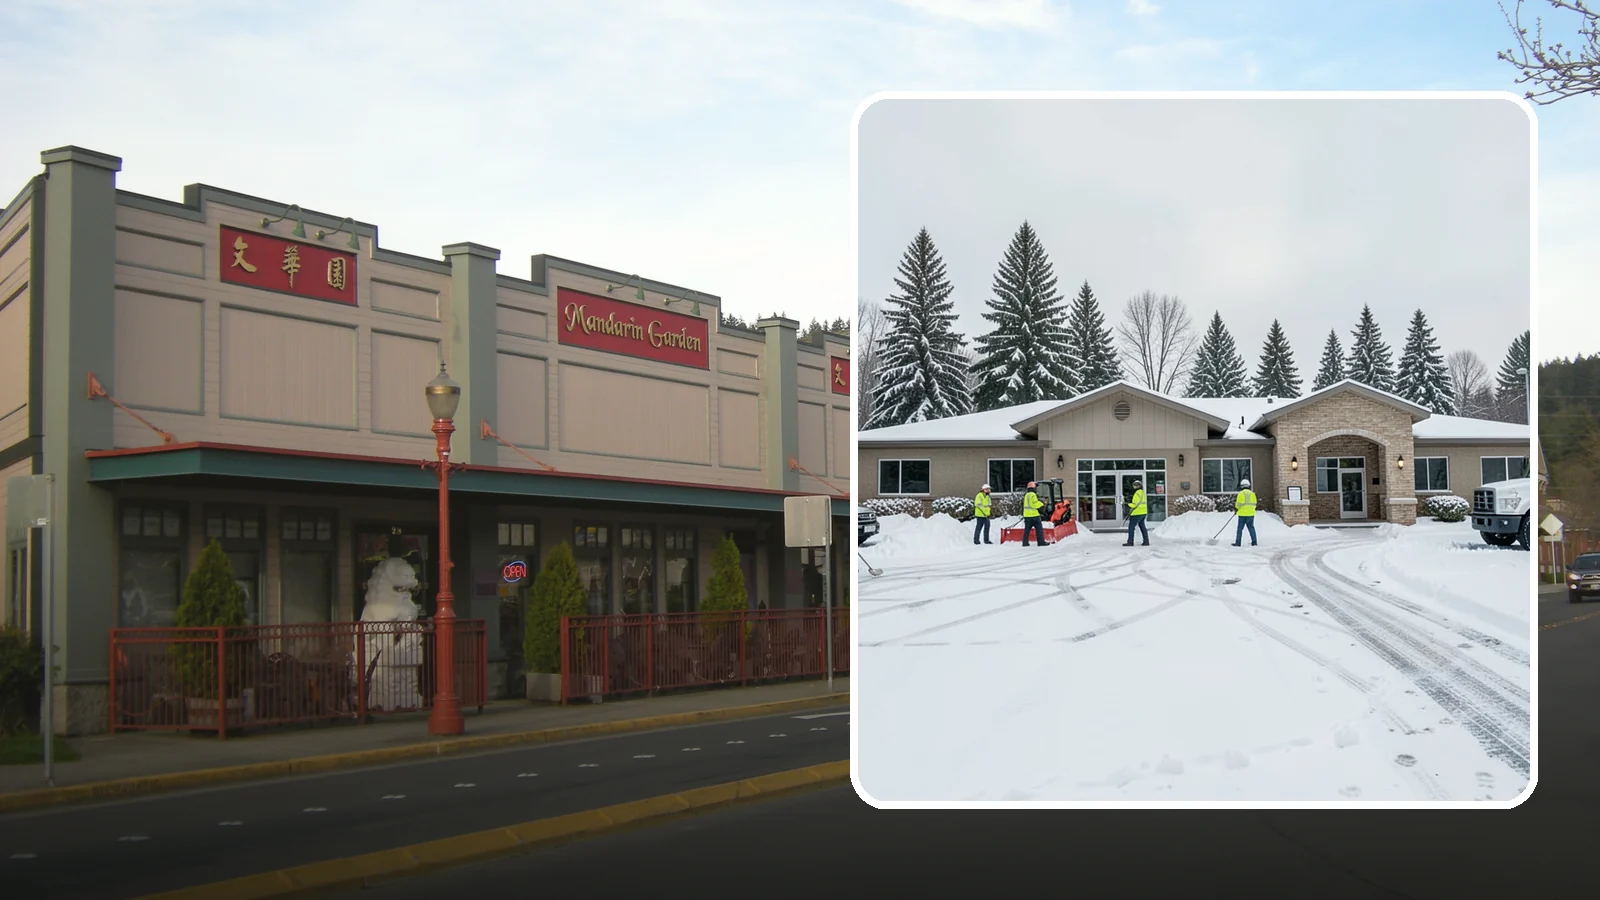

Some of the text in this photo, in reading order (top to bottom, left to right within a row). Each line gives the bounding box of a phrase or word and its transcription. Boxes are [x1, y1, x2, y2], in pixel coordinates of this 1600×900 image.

[231, 235, 347, 291] 文華園
[564, 302, 702, 352] Mandarin Garden
[503, 565, 527, 578] OPEN
